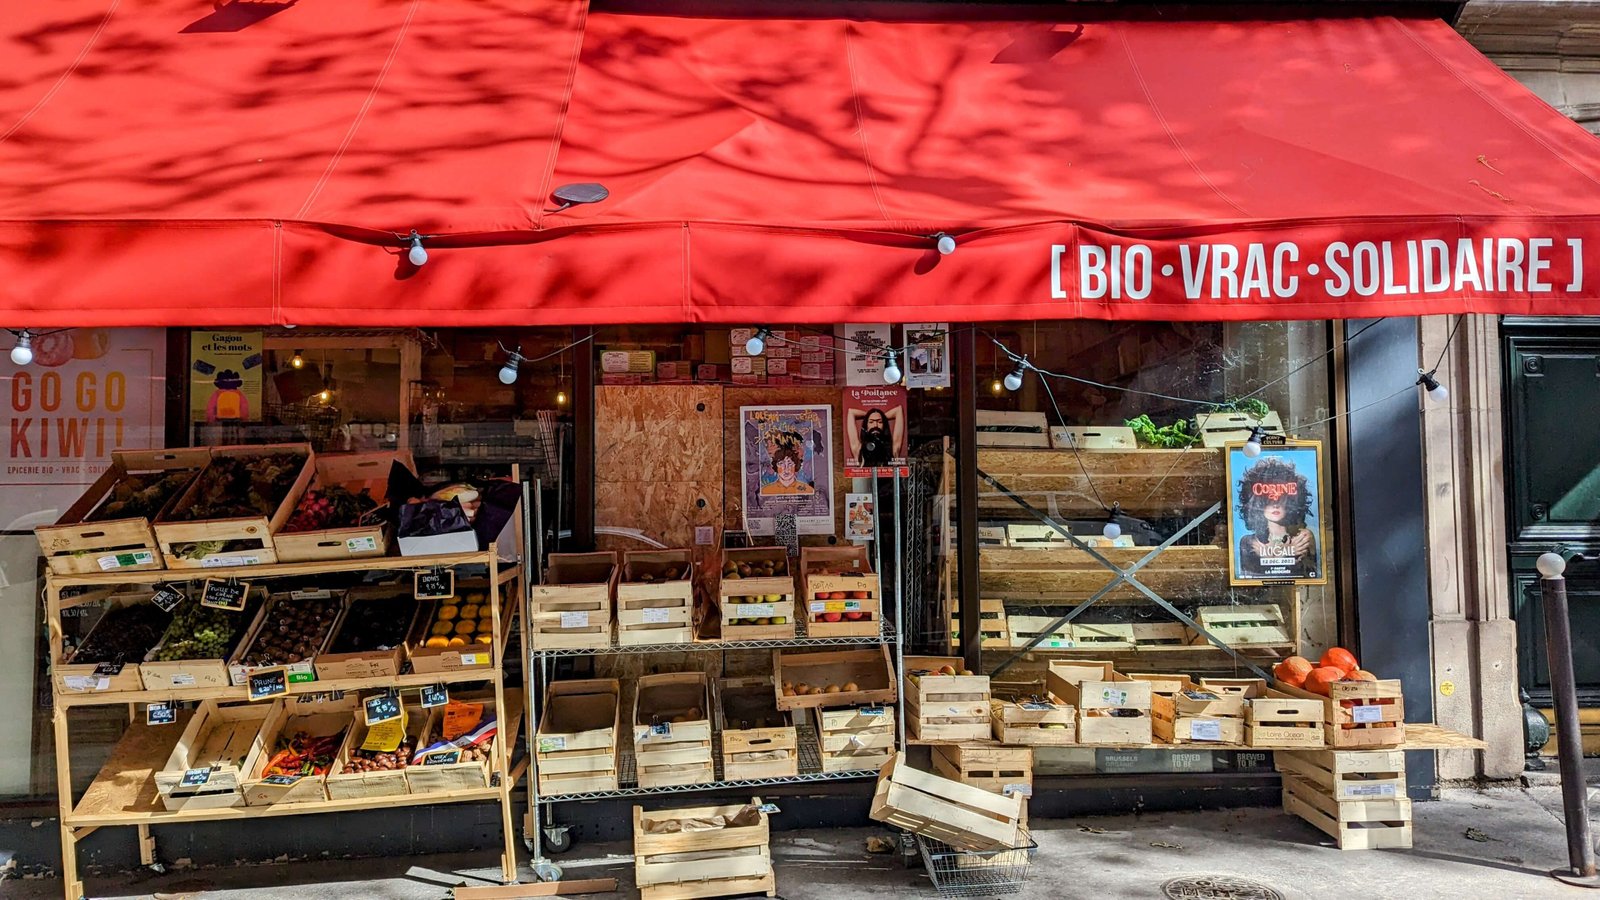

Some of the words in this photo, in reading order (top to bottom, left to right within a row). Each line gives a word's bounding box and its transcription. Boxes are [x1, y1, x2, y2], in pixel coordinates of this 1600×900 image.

[213, 343, 226, 351] les
[11, 371, 62, 413] GO
[76, 371, 126, 413] GO
[41, 466, 54, 474] BIO
[61, 466, 80, 474] VRAC
[1253, 482, 1298, 497] CORINE
[252, 676, 277, 688] PRUNE
[1171, 753, 1200, 761] BREWED
[1236, 753, 1266, 761] BREWED
[1172, 760, 1183, 768] TO
[1237, 760, 1247, 768] TO
